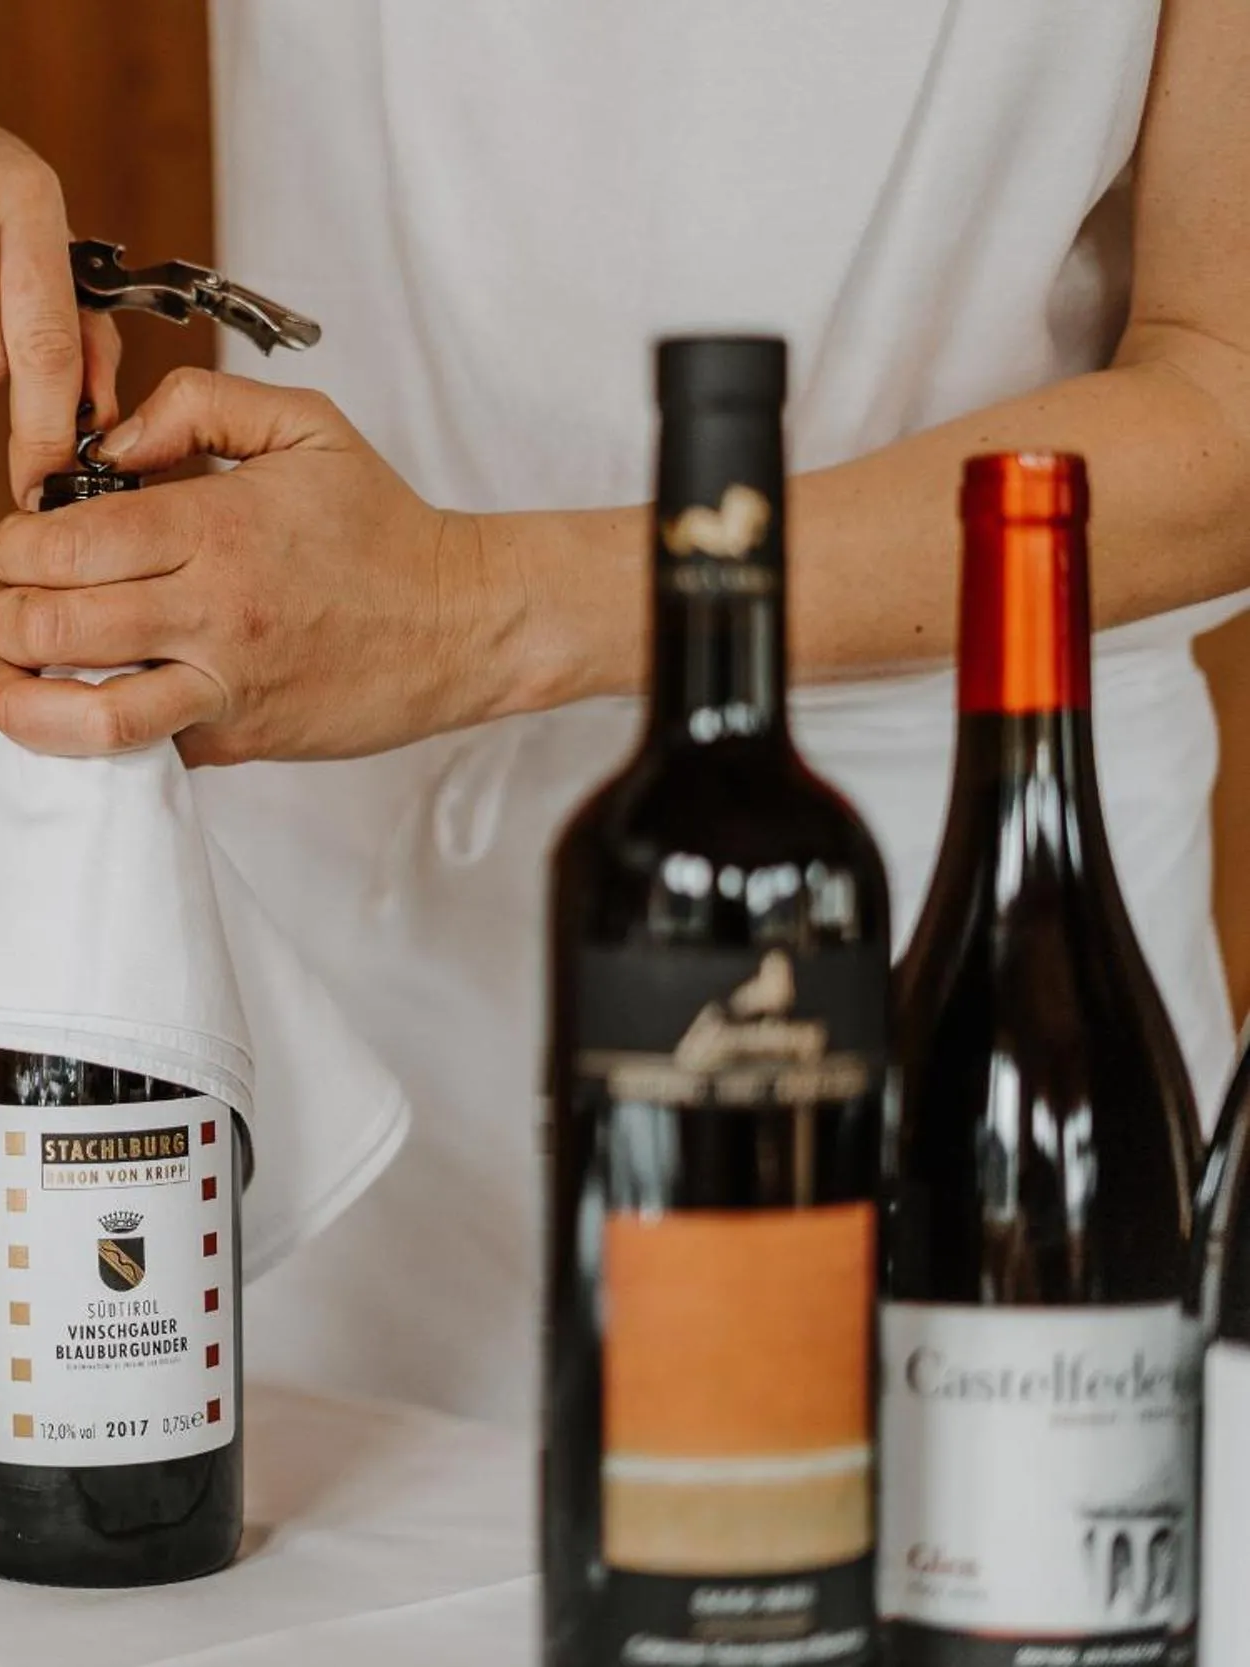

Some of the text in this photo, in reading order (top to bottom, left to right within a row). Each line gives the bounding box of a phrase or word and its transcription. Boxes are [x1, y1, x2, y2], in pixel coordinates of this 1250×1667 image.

[44, 1133, 185, 1161] STACHLBURG
[106, 1169, 138, 1183] VON
[87, 1299, 159, 1319] SÜDTIROL
[68, 1318, 177, 1340] VINSCHGAUER
[56, 1336, 188, 1360] BLAUBURGUNDER
[40, 1422, 77, 1441] 12,0%
[79, 1423, 96, 1439] vol
[106, 1419, 150, 1438] 2017
